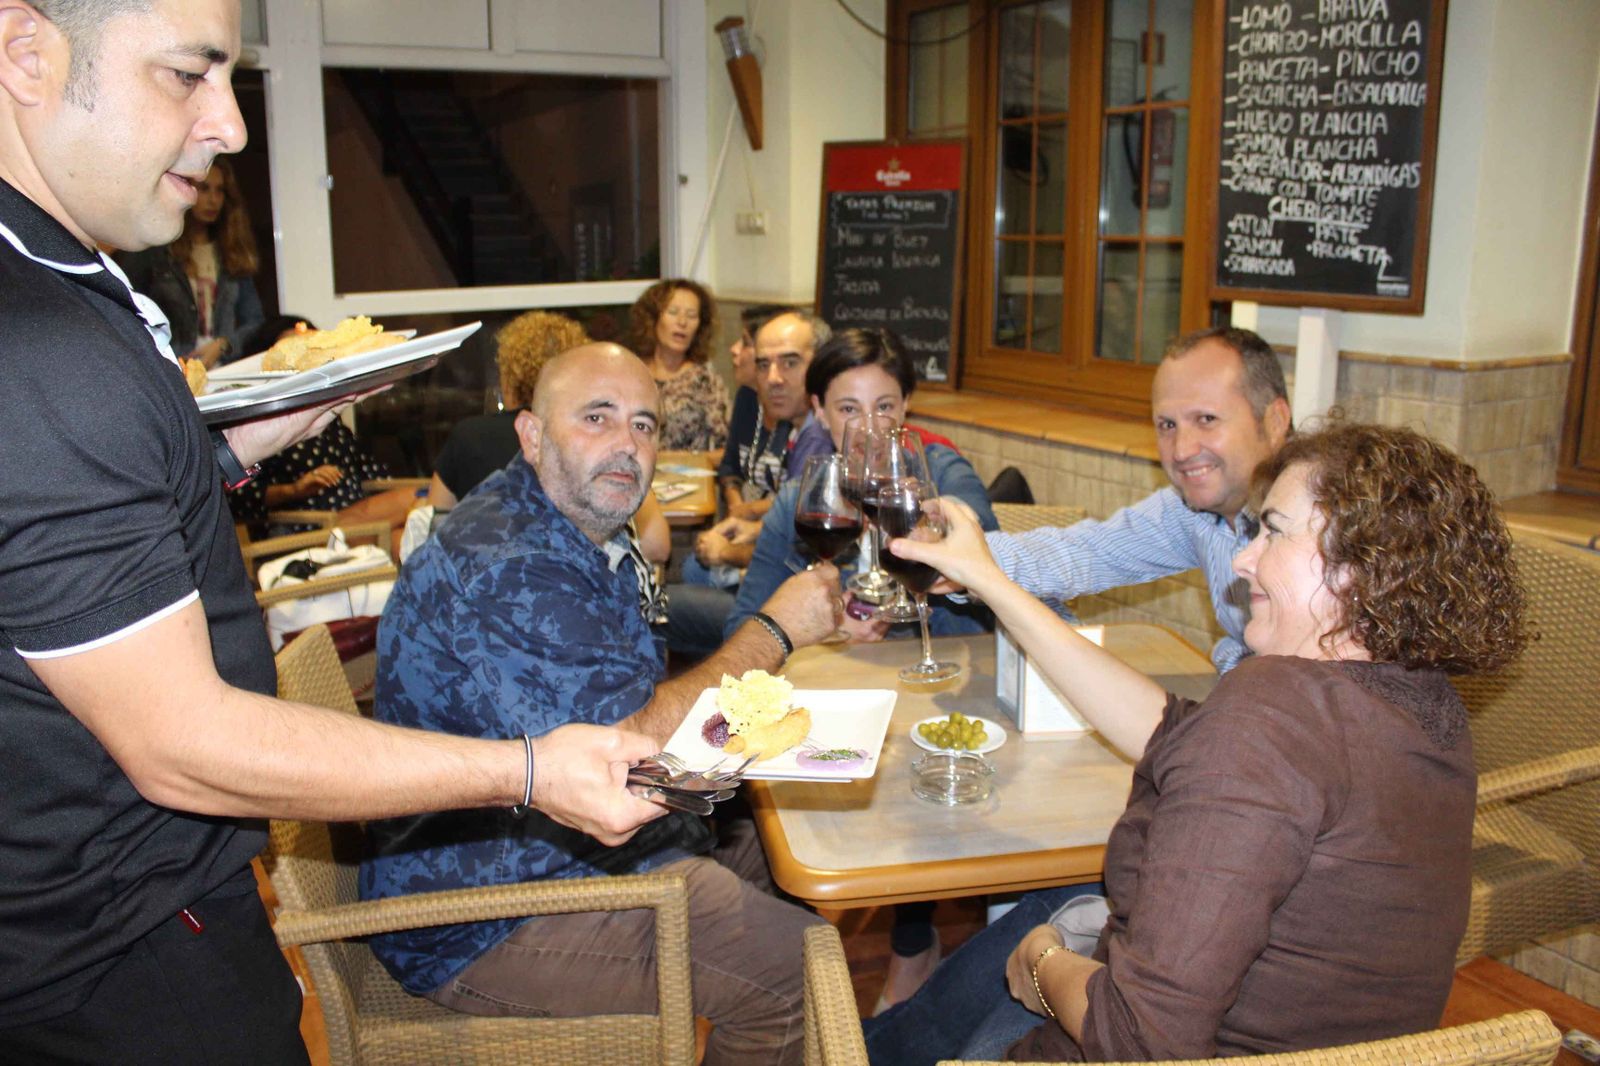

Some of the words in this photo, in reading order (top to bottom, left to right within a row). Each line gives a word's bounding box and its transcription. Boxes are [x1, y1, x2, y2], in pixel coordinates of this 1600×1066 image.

[1299, 111, 1388, 136] PLANCHA
[1293, 137, 1378, 161] PLANCHA
[1278, 179, 1307, 198] CON
[1310, 182, 1382, 207] TOMATE
[1232, 234, 1283, 256] JAMON
